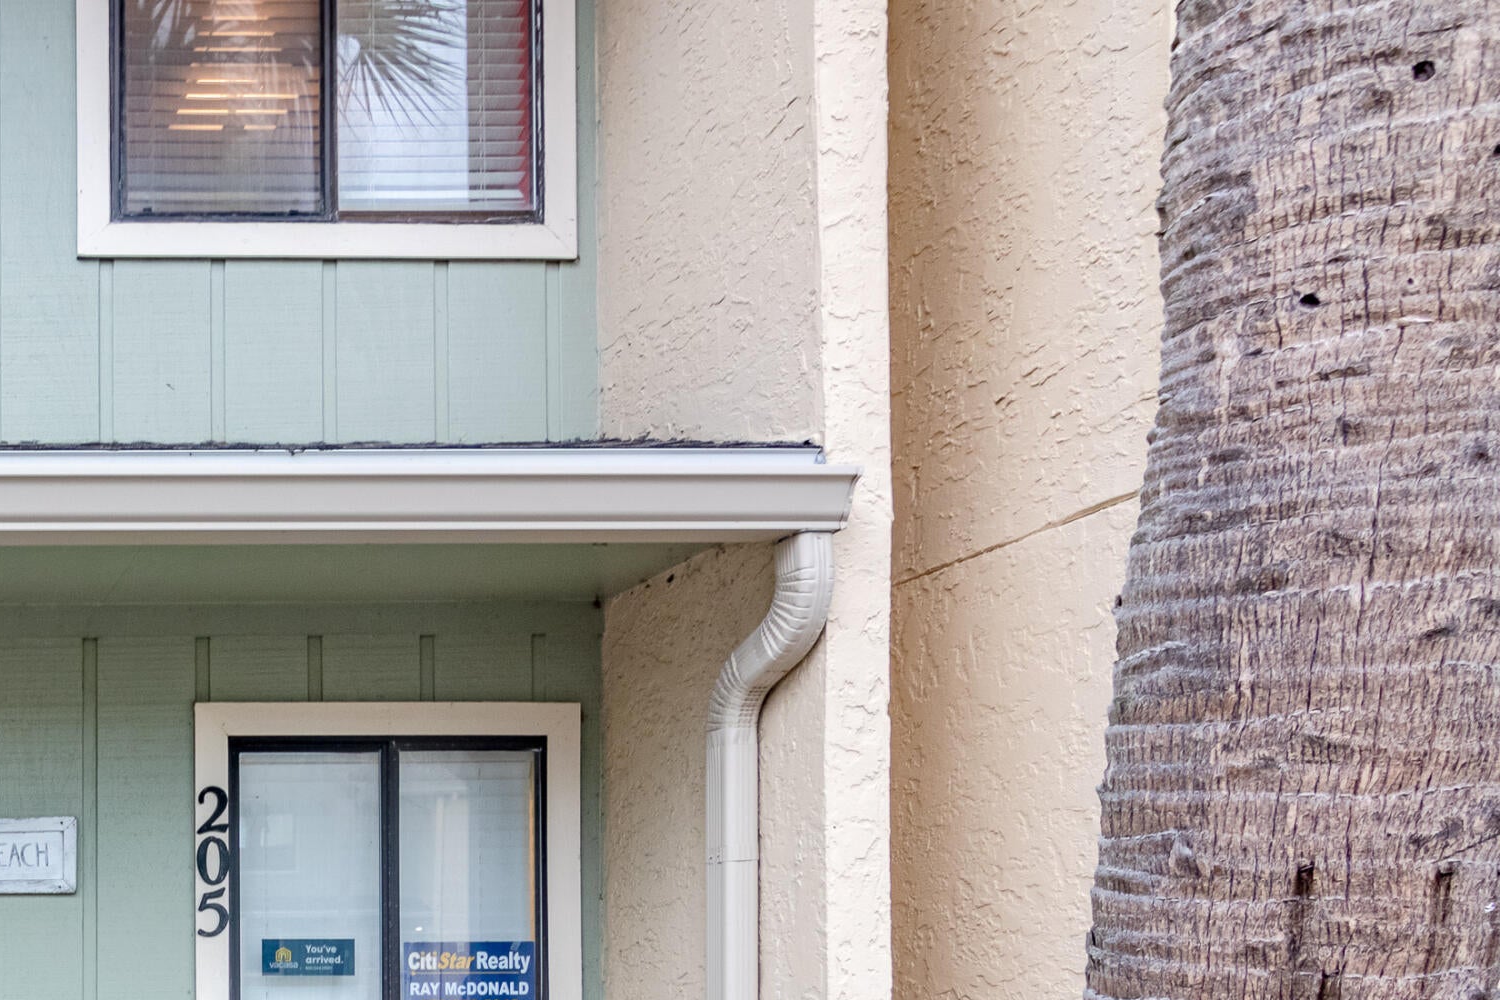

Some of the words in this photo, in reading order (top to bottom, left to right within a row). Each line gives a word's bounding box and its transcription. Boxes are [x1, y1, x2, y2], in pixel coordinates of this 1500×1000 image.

[197, 785, 230, 938] 205
[305, 945, 337, 954] You've
[305, 955, 344, 964] arrived.
[476, 951, 531, 974] Realty
[409, 981, 441, 996] RAY
[444, 981, 530, 996] McDONALD
